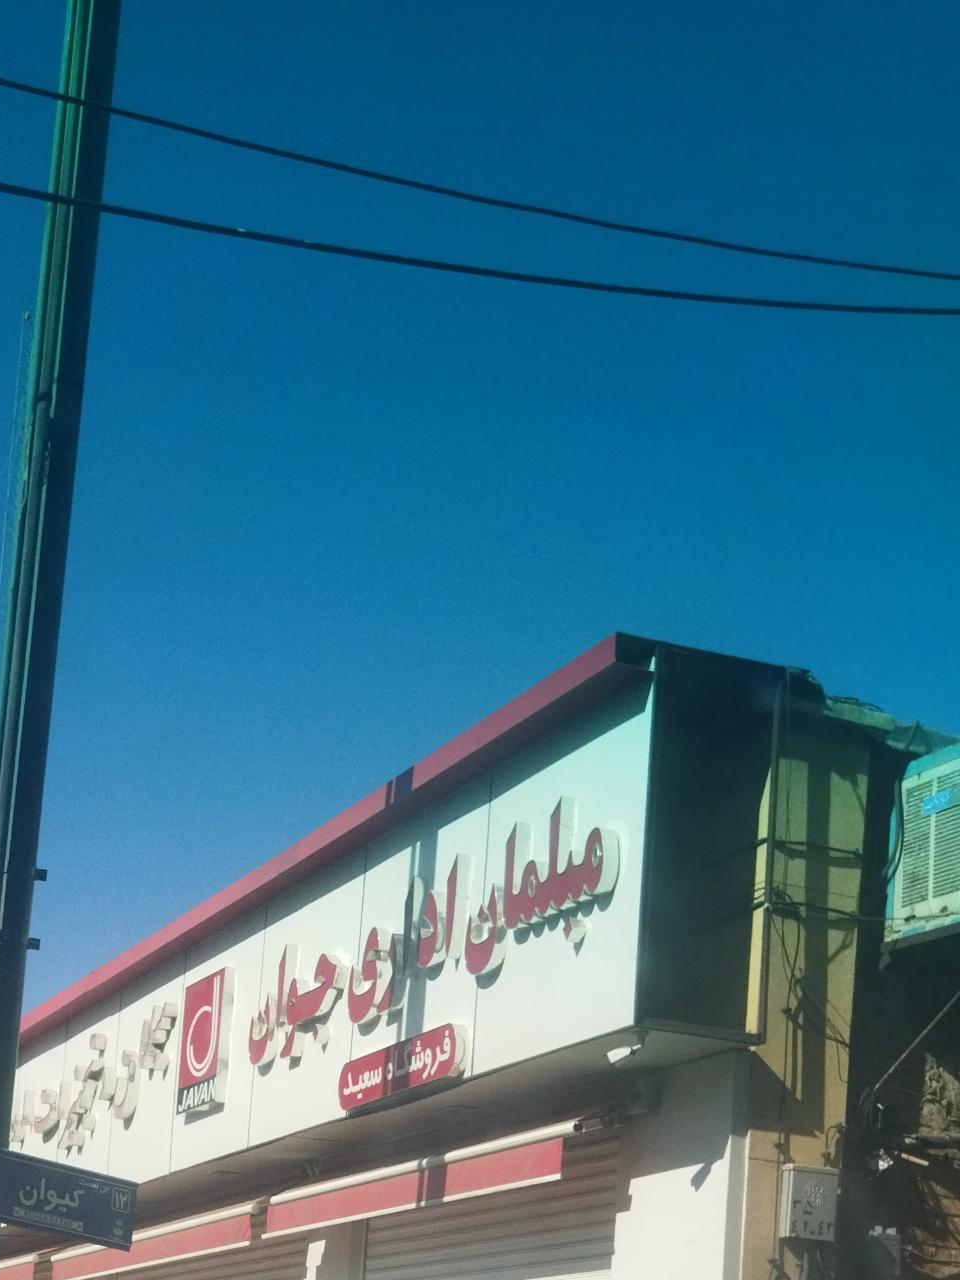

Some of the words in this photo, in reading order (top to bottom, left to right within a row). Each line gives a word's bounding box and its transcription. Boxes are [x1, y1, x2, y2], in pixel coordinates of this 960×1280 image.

[464, 796, 618, 976] مبلمان
[248, 944, 346, 1066] جوان
[385, 1029, 452, 1080] فروشگاه
[178, 1080, 217, 1112] JAVAN
[343, 1066, 383, 1099] سعید
[18, 1177, 86, 1212] کیوان
